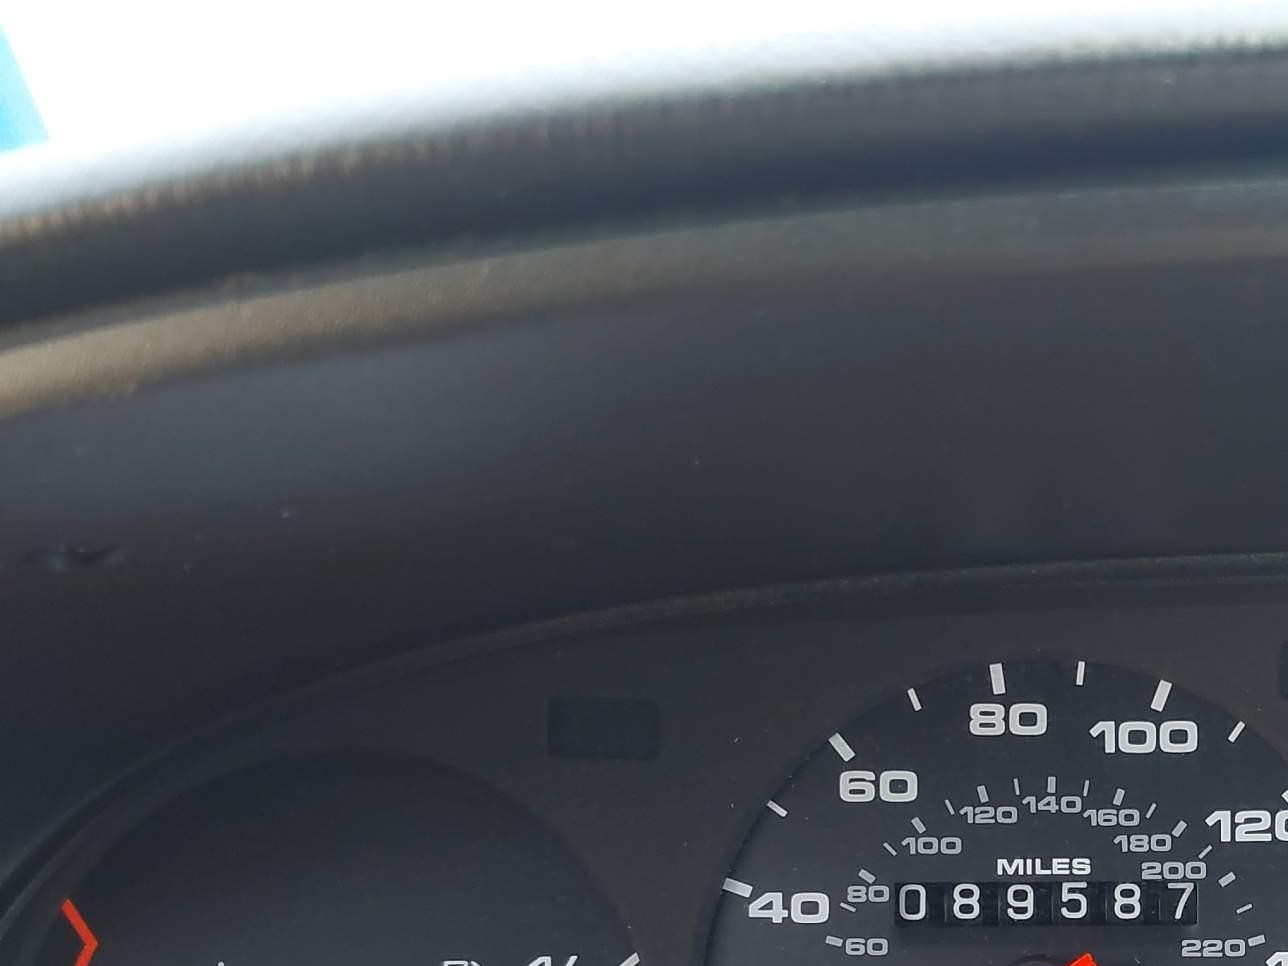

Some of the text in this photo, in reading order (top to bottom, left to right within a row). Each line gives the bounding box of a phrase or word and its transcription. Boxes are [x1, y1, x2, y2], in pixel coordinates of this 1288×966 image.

[969, 703, 1048, 736] 80
[1089, 720, 1198, 753] 100
[839, 770, 918, 802] 60
[1021, 796, 1082, 813] 140
[959, 806, 1018, 824] 120
[1083, 808, 1140, 826] 160
[901, 837, 963, 855] 100
[1113, 834, 1172, 852] 180
[997, 858, 1091, 876] MILES
[1141, 861, 1207, 880] 200
[847, 885, 890, 902] 80
[748, 891, 830, 924] 40
[845, 938, 888, 956] 60
[1181, 939, 1246, 957] 220
